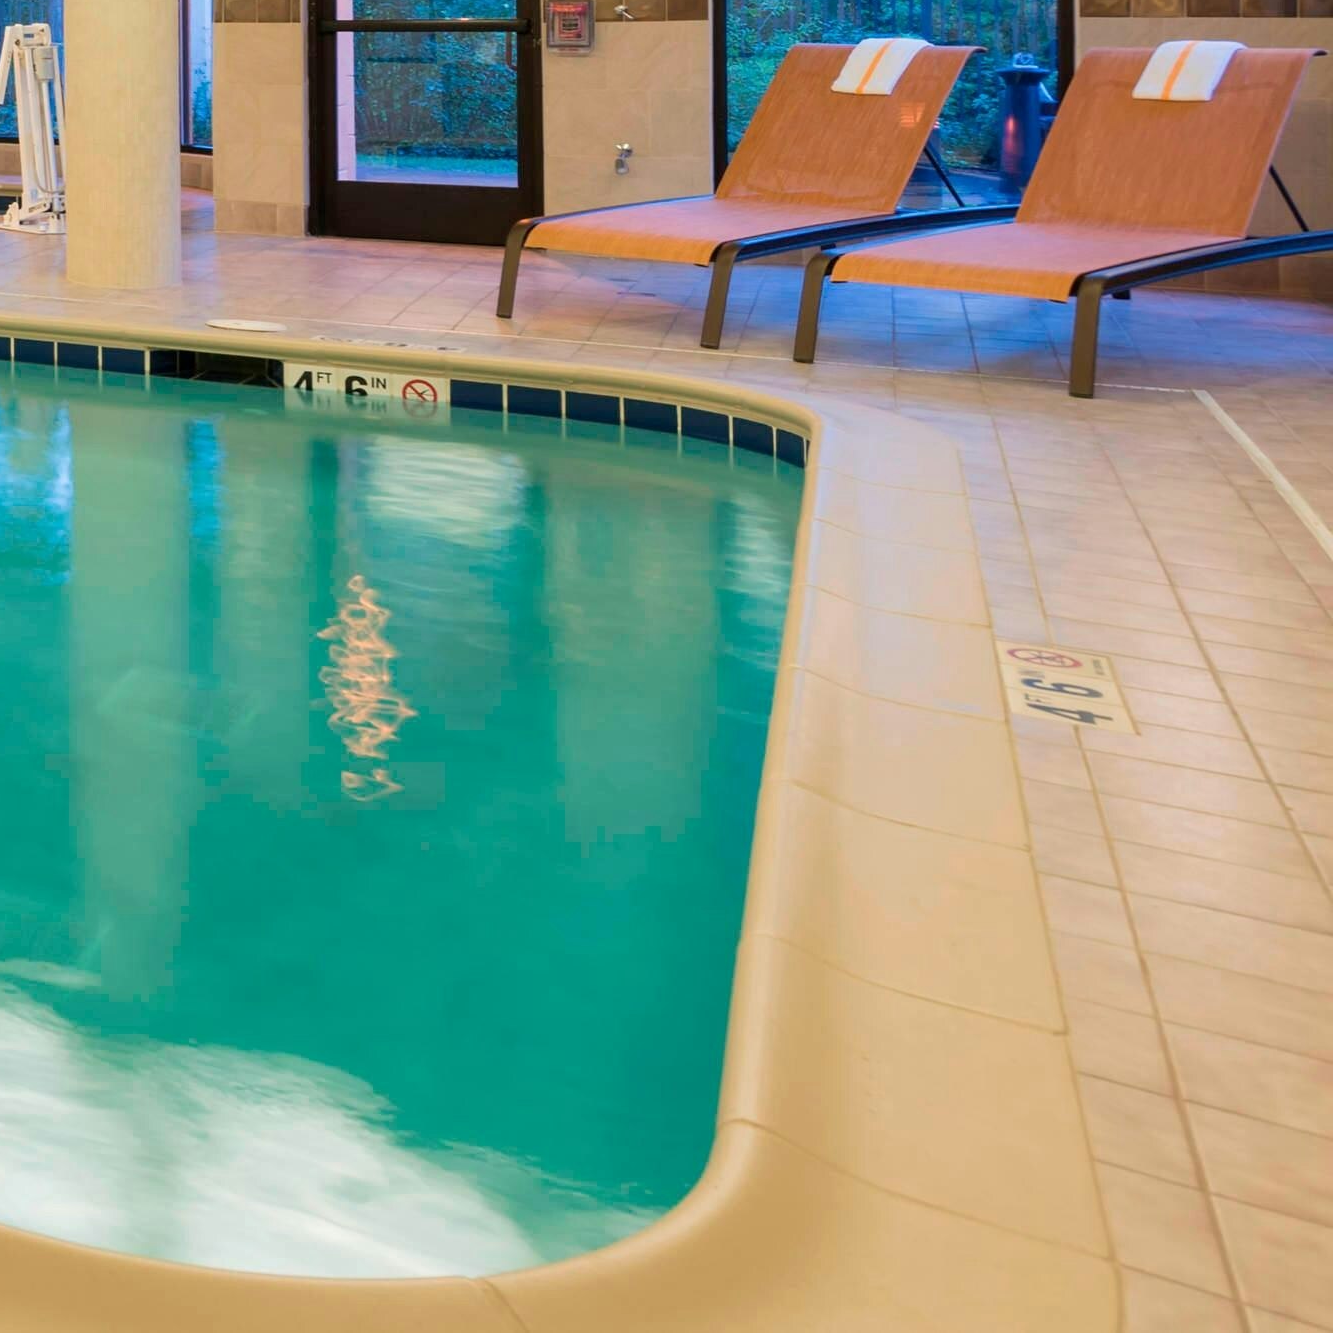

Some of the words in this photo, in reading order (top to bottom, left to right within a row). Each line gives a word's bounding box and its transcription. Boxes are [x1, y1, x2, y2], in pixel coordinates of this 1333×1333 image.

[317, 372, 333, 384] FT
[345, 375, 368, 396] 6
[371, 377, 387, 390] IN
[1020, 678, 1104, 698] 6
[1026, 702, 1113, 726] 4
